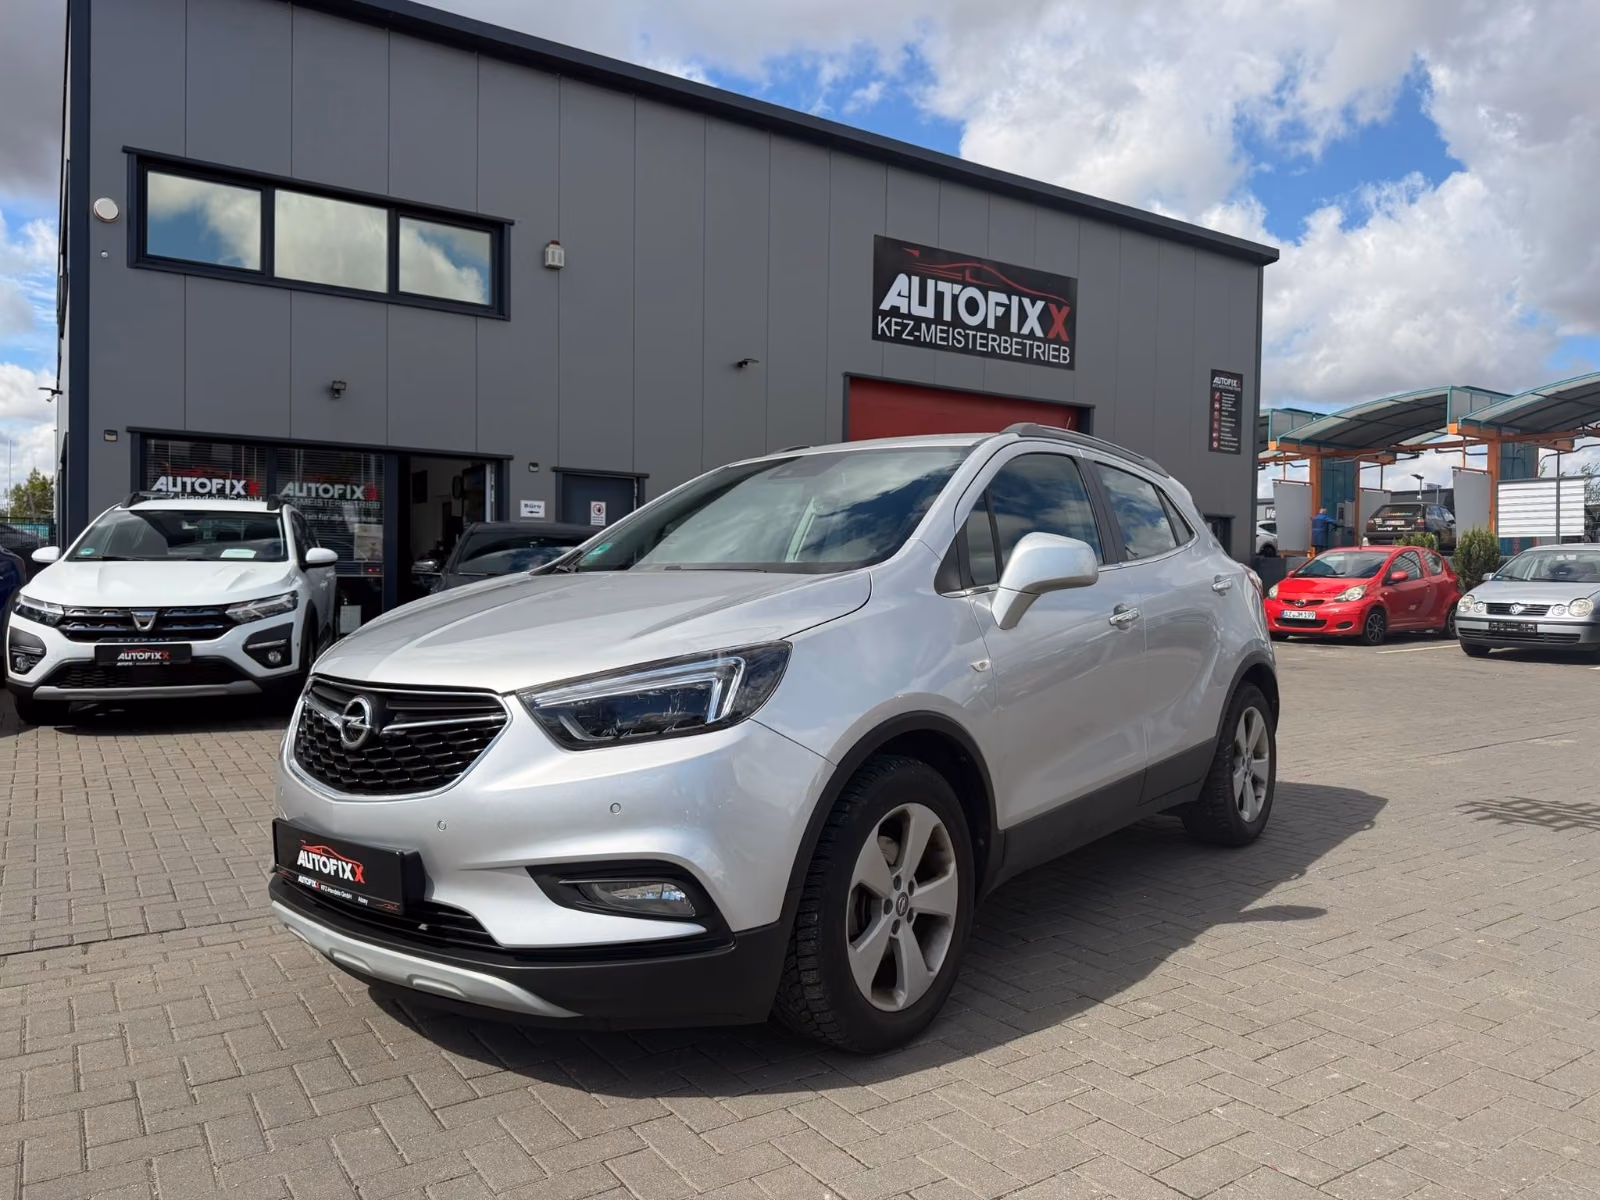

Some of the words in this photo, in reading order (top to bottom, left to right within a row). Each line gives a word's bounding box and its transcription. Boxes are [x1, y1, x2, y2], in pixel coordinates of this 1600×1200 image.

[878, 273, 1071, 342] AUTOFIXX
[877, 315, 1070, 364] KFZ-MEISTERBETRIEB
[117, 652, 169, 660] AUTOFIXX
[297, 850, 365, 884] AUTOFIXX
